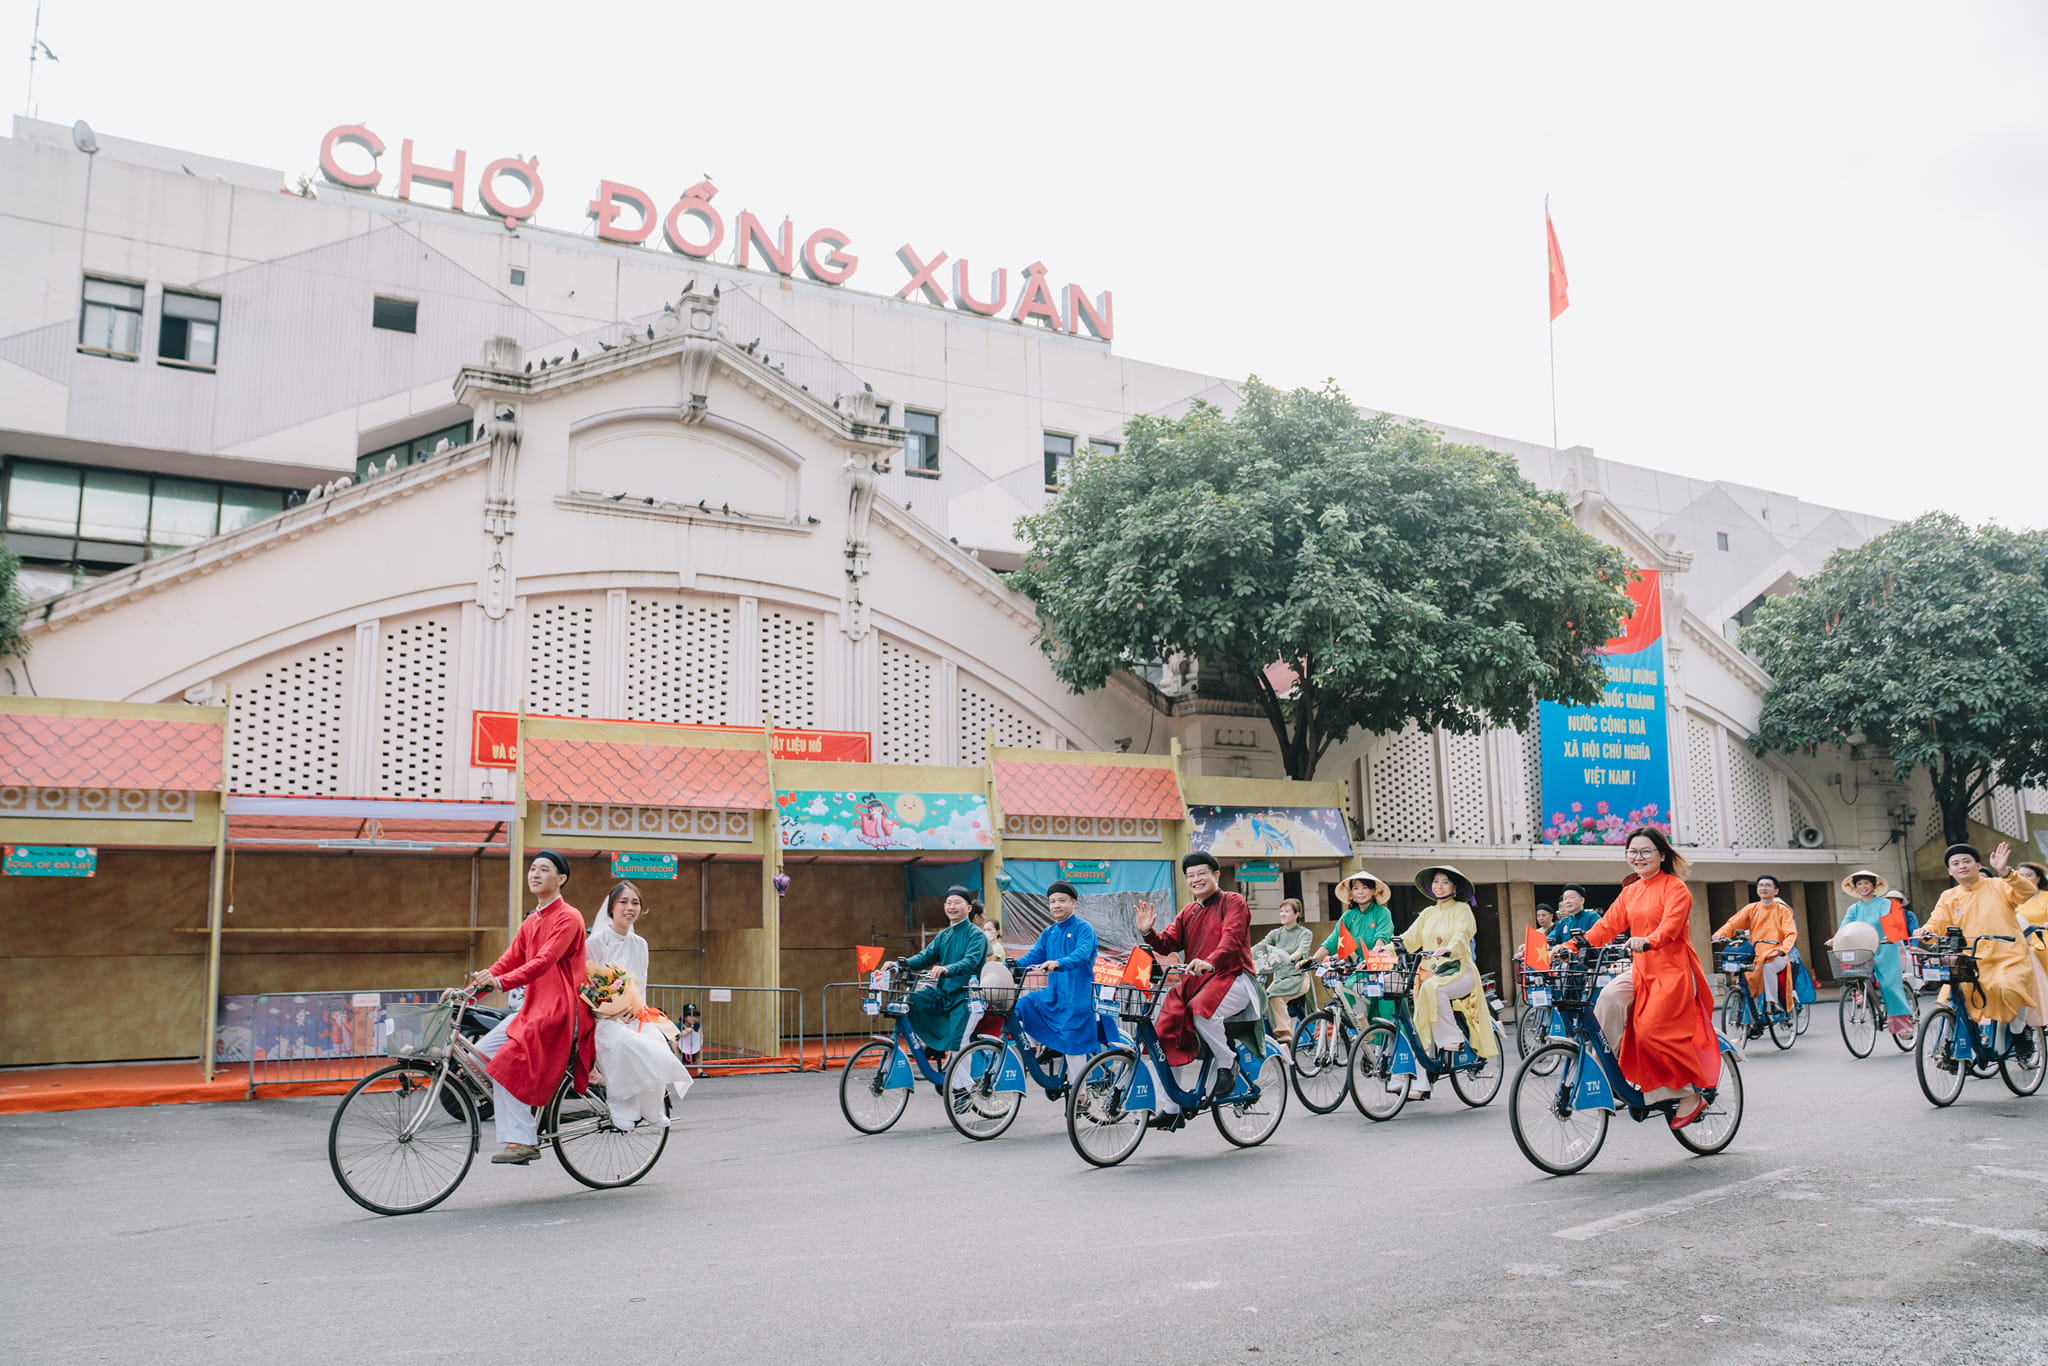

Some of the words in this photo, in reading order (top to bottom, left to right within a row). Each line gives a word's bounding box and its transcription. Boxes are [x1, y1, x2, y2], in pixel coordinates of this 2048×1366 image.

[319, 124, 545, 231] CHỢ
[586, 180, 859, 285] ĐỒNG
[895, 243, 1113, 340] XUÂN
[1606, 664, 1631, 683] CHÀO
[1633, 667, 1657, 685] MỪNG
[1626, 691, 1655, 710] KHÁNH
[1568, 713, 1598, 732] NƯỚC
[1600, 714, 1627, 736] CỘNG
[492, 742, 506, 760] VÀ
[786, 736, 807, 755] LIỆU
[1564, 739, 1579, 758] XÃ
[1582, 739, 1600, 761] HỘI
[1602, 739, 1622, 759] CHỦ
[1624, 742, 1651, 760] NGHĨA
[1584, 766, 1606, 788] VIỆT
[1608, 770, 1630, 785] NAM
[5, 861, 35, 869] SOUL
[37, 861, 52, 869] OF
[616, 865, 645, 873] BLUME
[1064, 871, 1106, 879] SCREATIVE
[1005, 1070, 1017, 1078] TN
[1136, 1084, 1148, 1095] TN
[1586, 1080, 1600, 1092] TN
